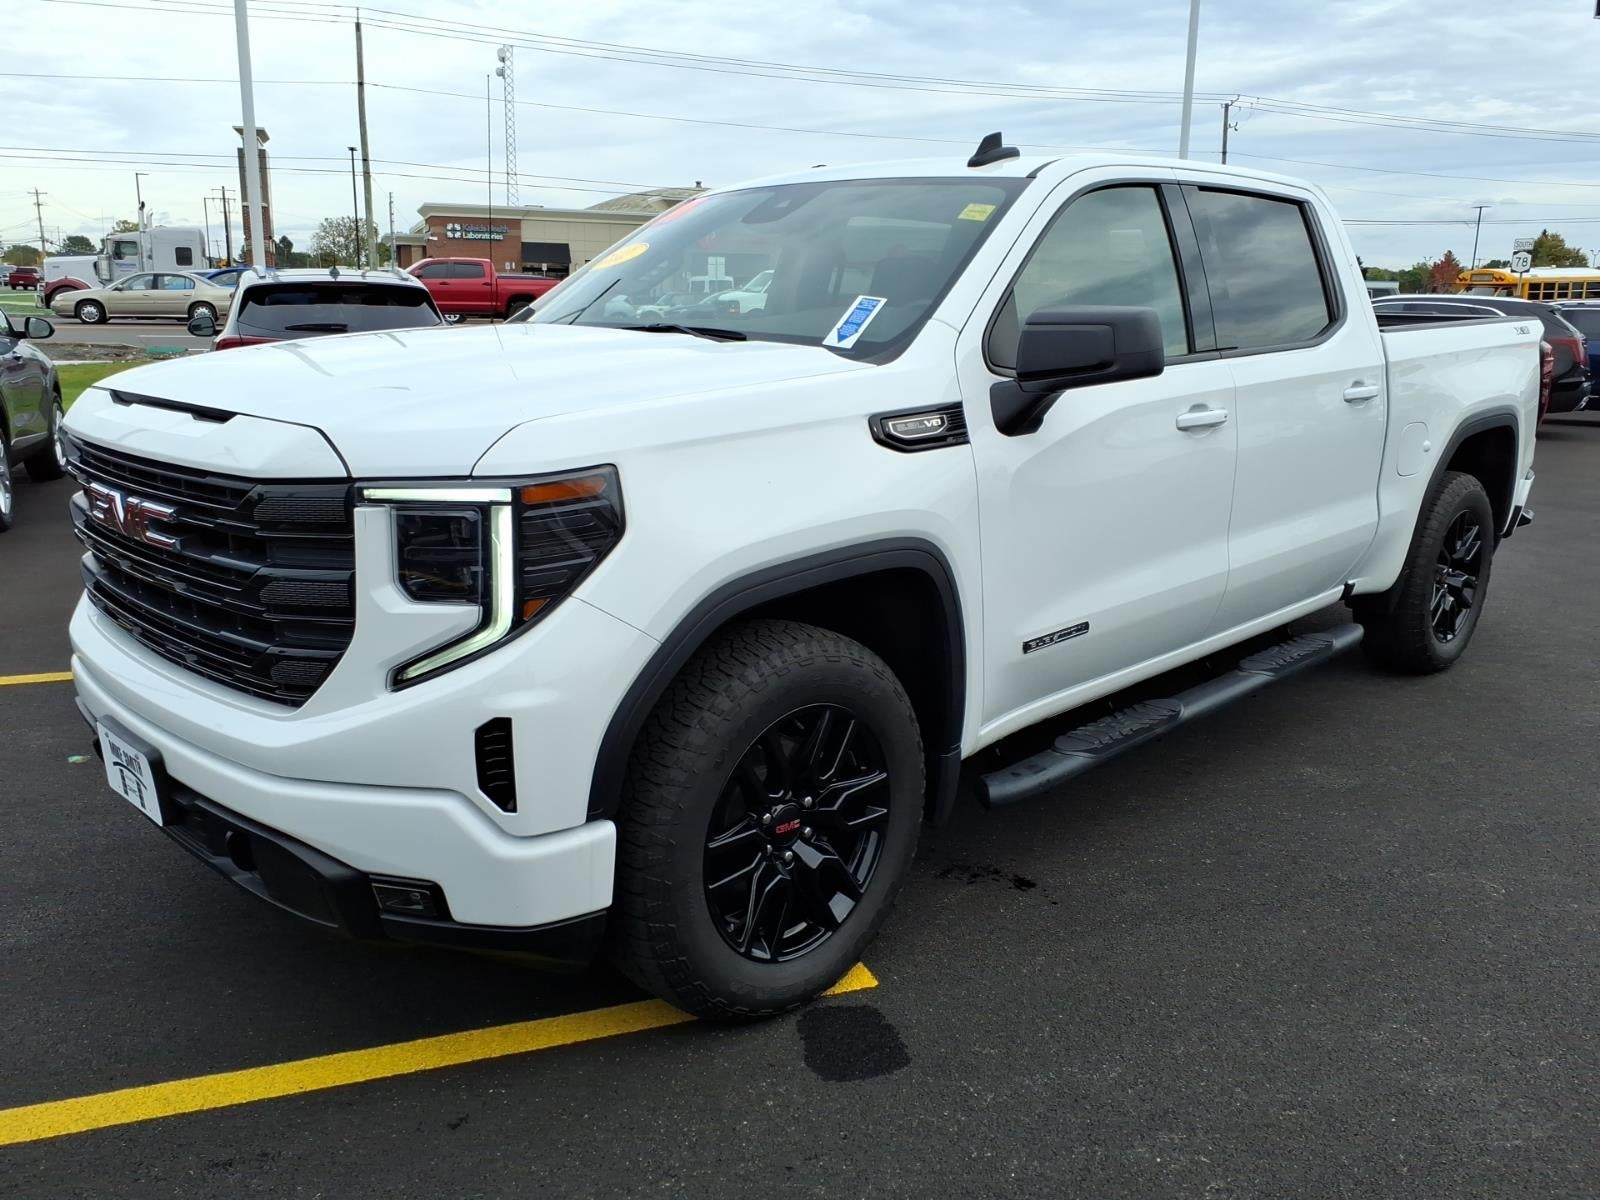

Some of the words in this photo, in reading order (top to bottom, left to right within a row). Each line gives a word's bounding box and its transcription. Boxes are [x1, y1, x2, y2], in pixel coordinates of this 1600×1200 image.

[463, 231, 504, 240] Laboratories
[1514, 240, 1533, 248] SOUTH
[1515, 256, 1528, 267] 78
[87, 482, 181, 554] GMC
[775, 818, 801, 834] GMC
